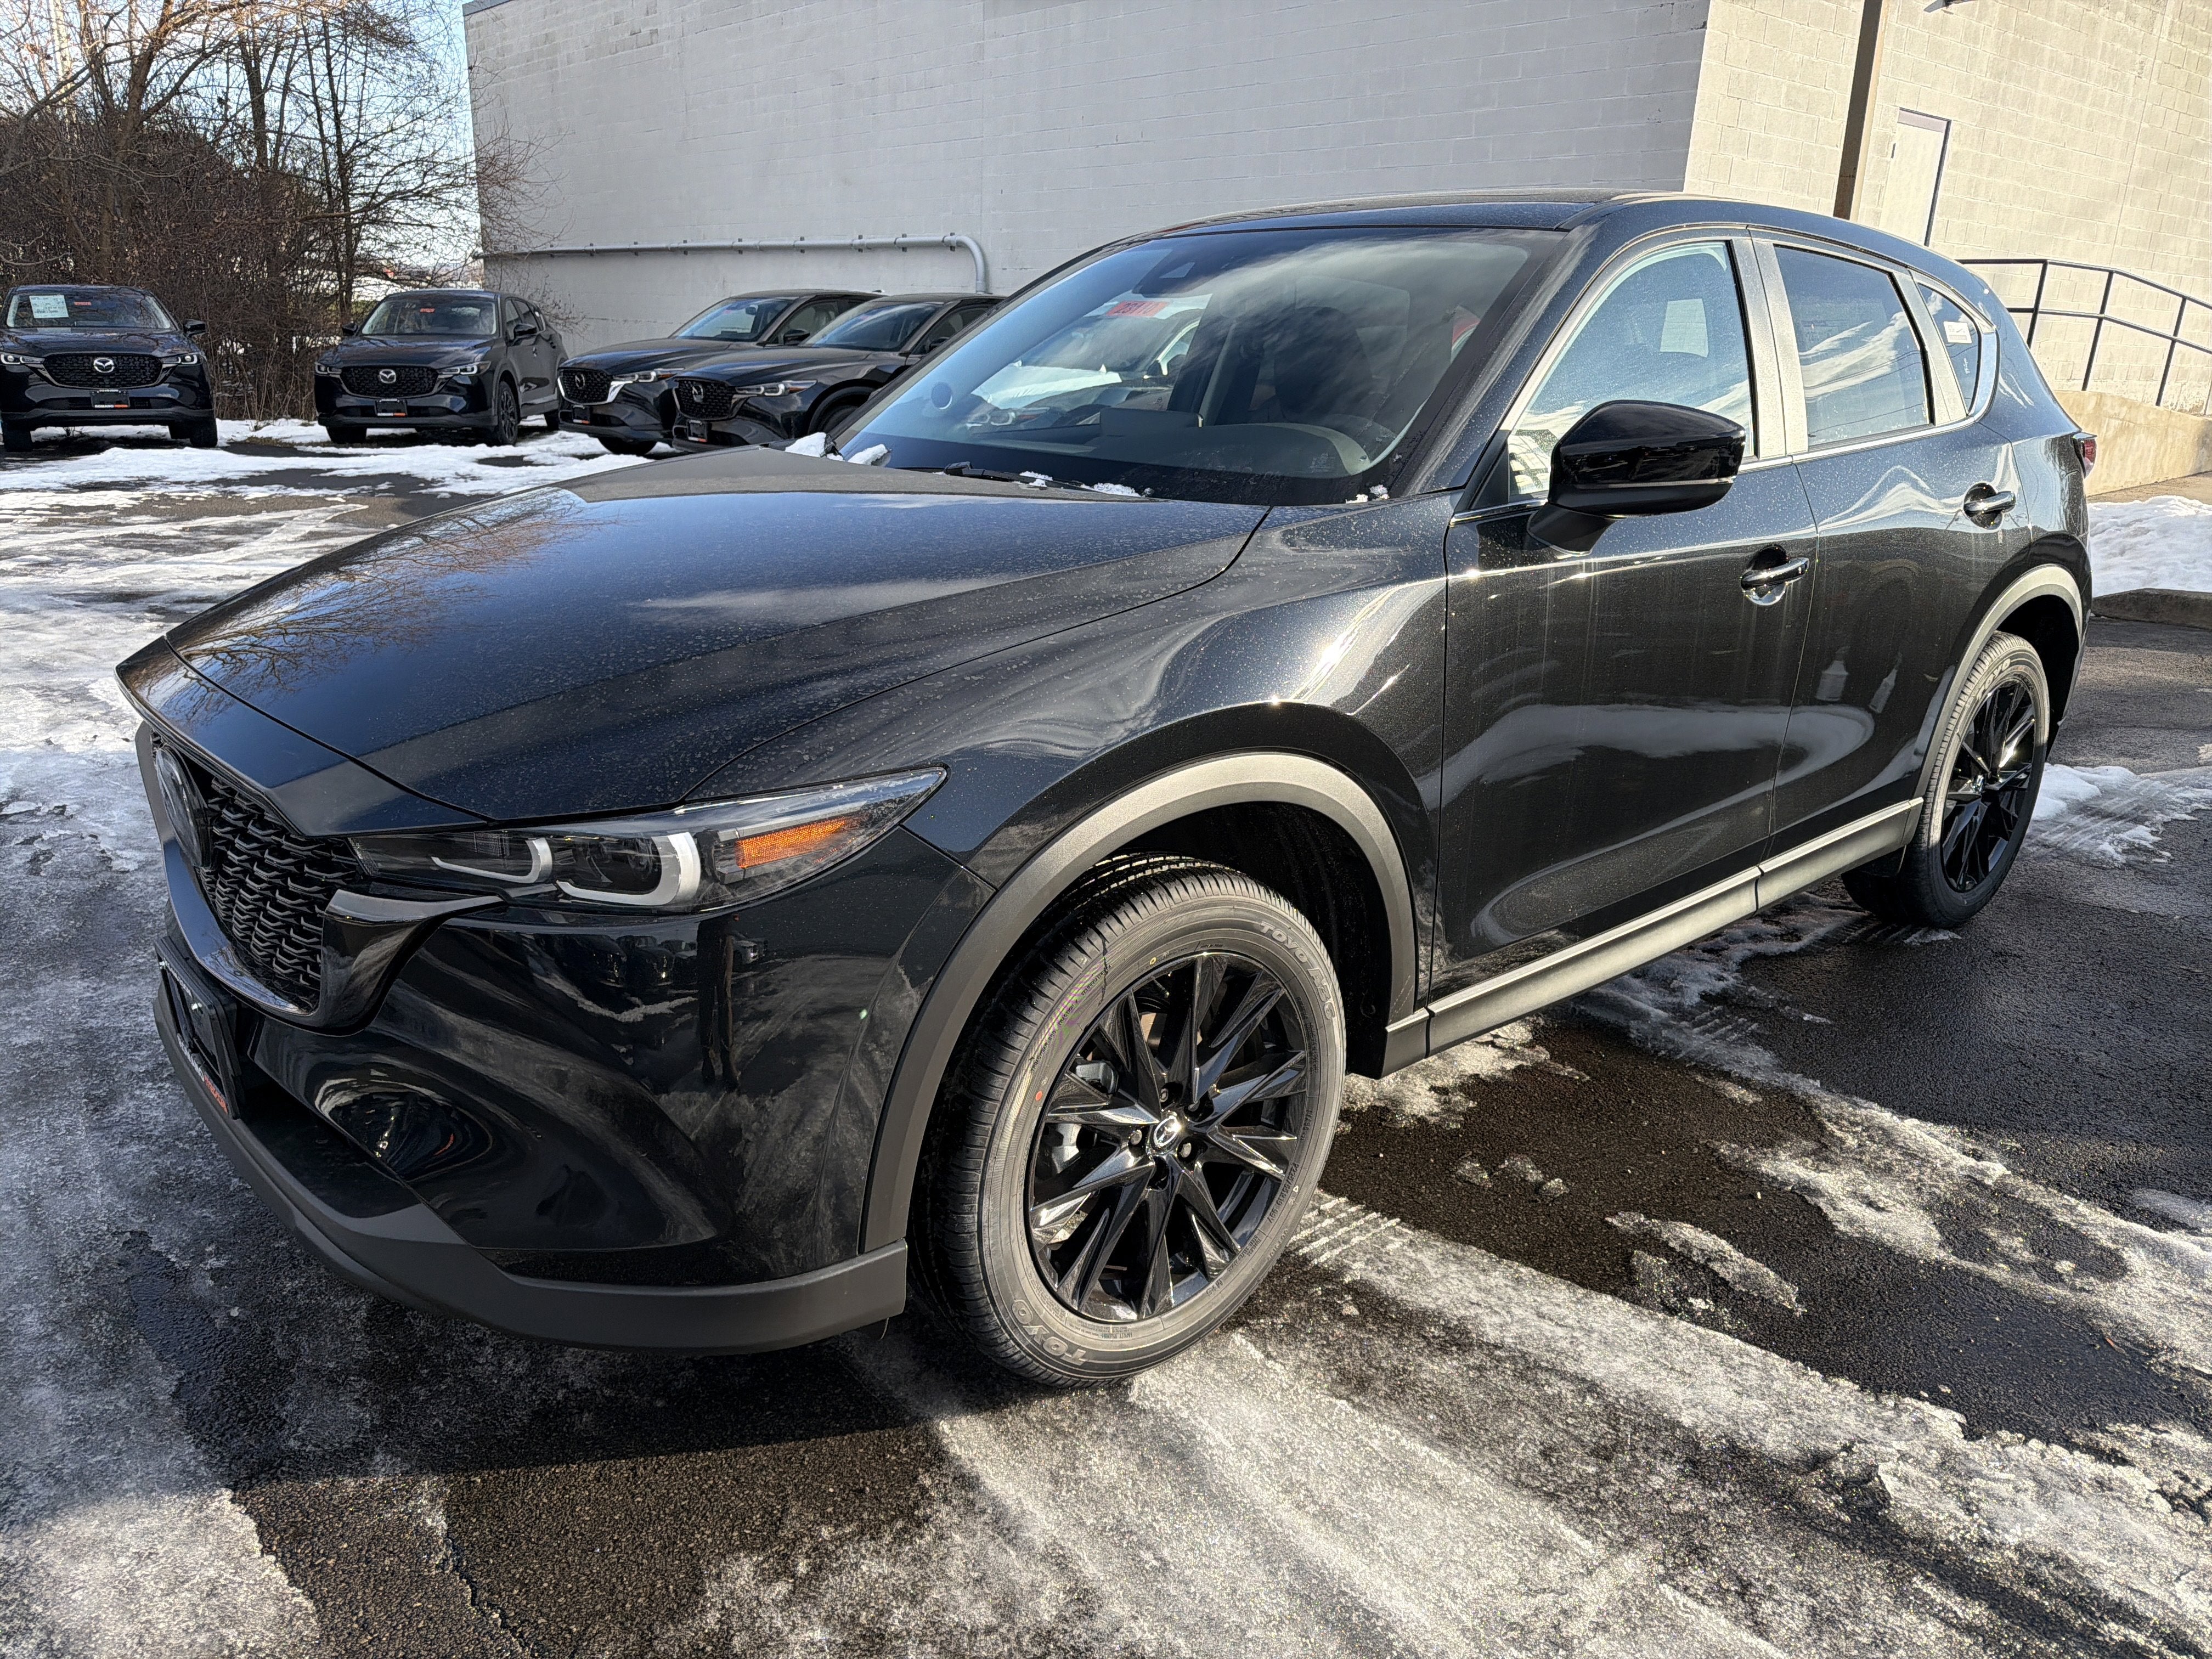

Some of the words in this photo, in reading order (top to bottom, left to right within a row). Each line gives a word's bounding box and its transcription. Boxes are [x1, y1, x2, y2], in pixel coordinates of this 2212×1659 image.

[1976, 658, 2011, 702] TOYO
[1260, 921, 1308, 963] TOYO
[1308, 967, 1336, 1020] A36
[1276, 1162, 1300, 1206] P225/55R19
[1267, 1208, 1279, 1224] 99V
[1012, 1299, 1087, 1367] TOYO
